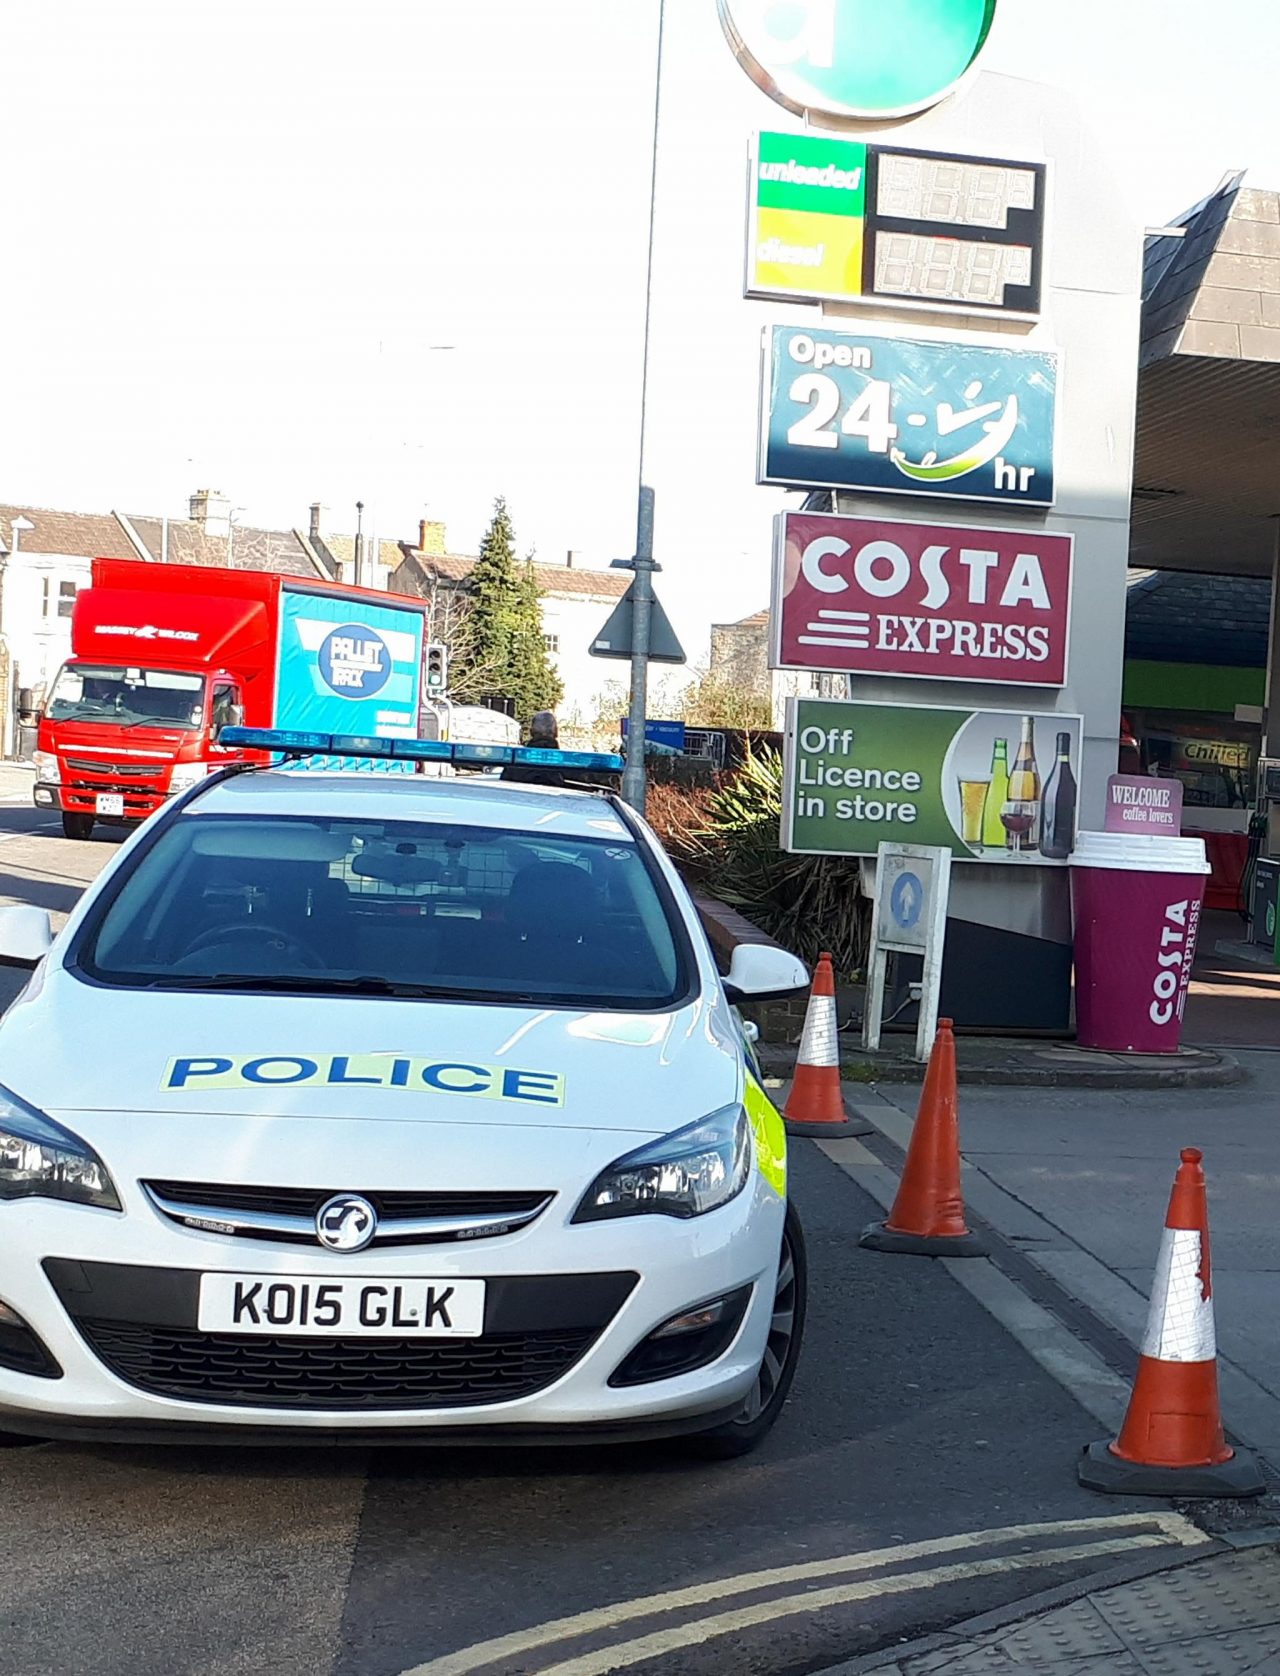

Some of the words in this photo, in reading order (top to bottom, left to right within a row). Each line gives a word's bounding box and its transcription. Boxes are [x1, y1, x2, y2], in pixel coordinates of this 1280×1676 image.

[759, 159, 862, 191] unleaded
[788, 334, 872, 369] Open
[787, 372, 898, 453] 24
[994, 457, 1035, 492] hr
[801, 535, 1052, 610] COSTA
[875, 614, 1050, 662] EXPRESS
[800, 726, 854, 755] Off
[798, 758, 922, 791] Licence
[798, 791, 825, 818] in
[835, 794, 917, 823] store
[1112, 784, 1171, 808] WELCOME
[1122, 807, 1147, 822] coffee
[1148, 808, 1174, 824] lovers
[1180, 899, 1201, 987] EXPRESS
[1149, 900, 1188, 1025] COSTA
[167, 1056, 560, 1104] POLICE
[233, 1281, 342, 1327] KO15
[359, 1286, 453, 1328] GLK
